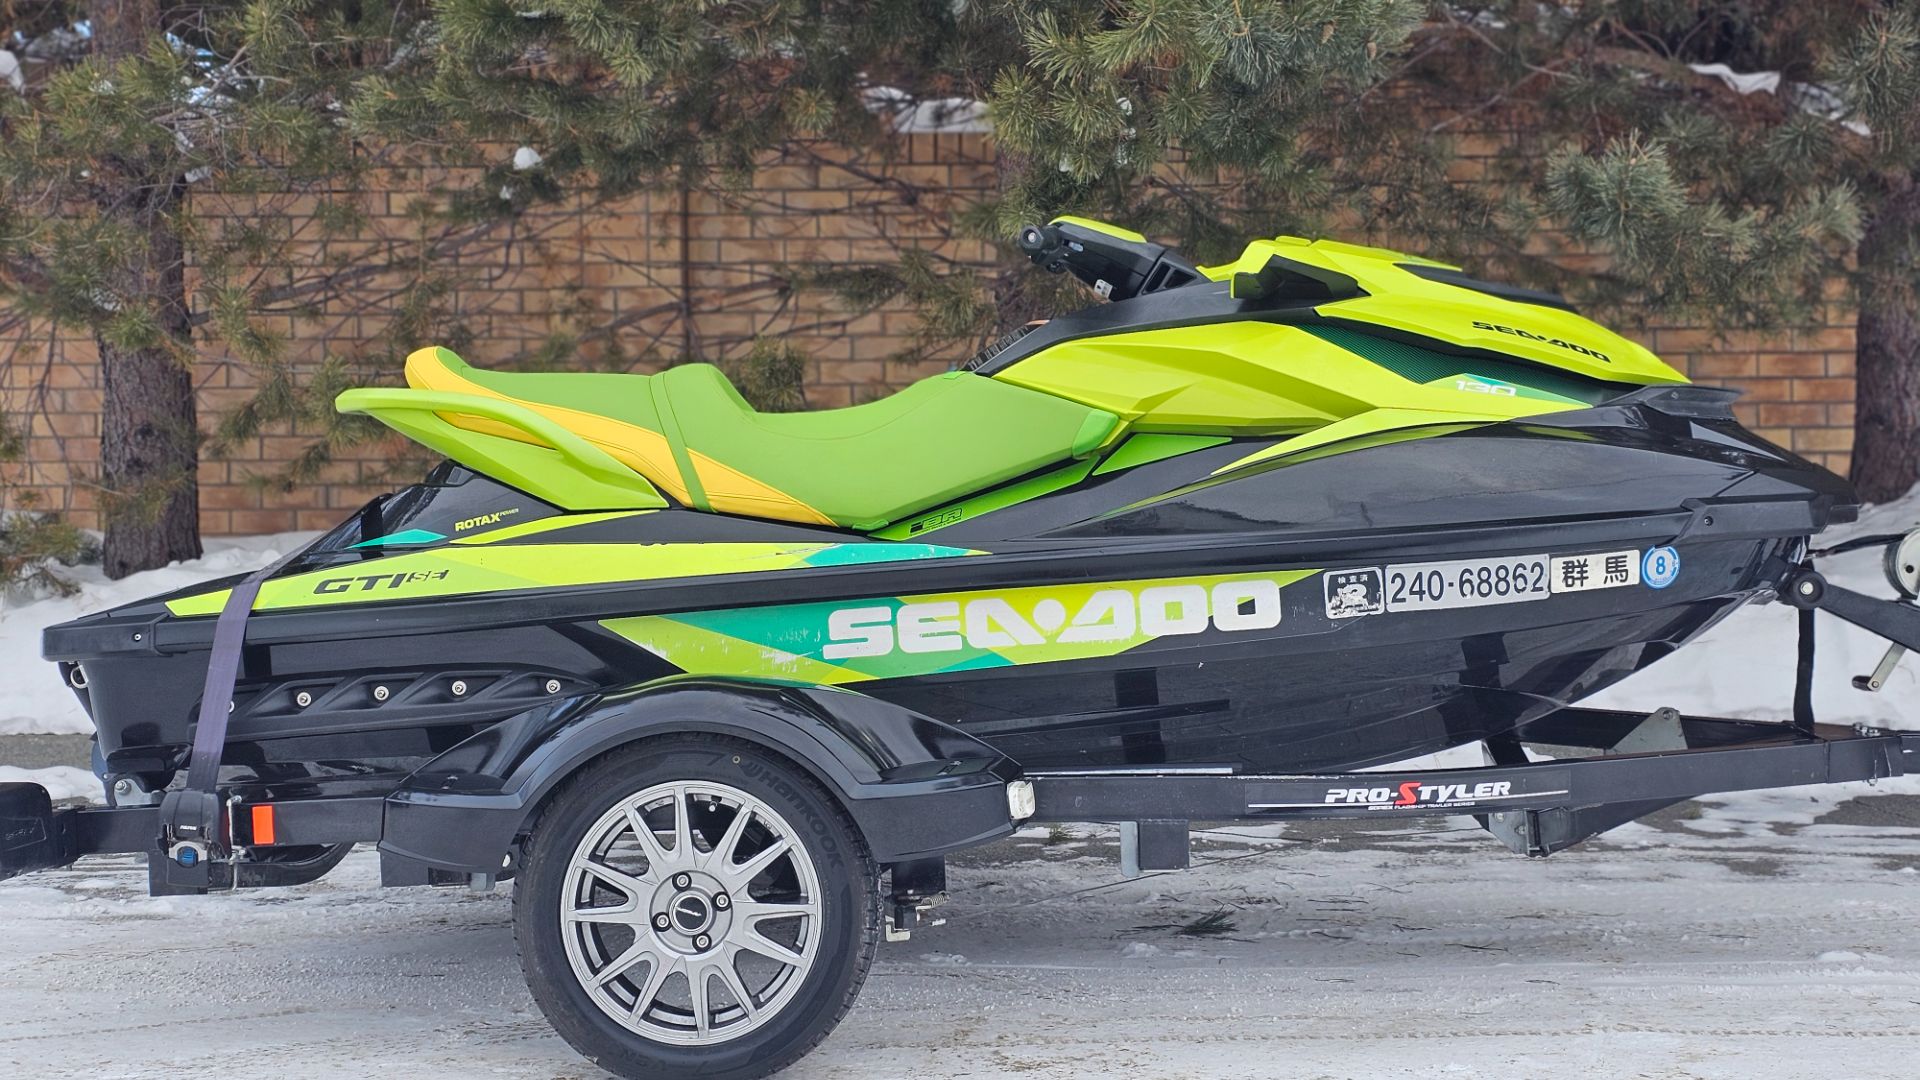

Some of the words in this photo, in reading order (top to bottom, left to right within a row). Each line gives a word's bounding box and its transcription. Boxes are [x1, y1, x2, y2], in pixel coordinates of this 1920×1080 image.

[1455, 379, 1517, 397] 130
[455, 512, 501, 532] ROTAX
[500, 508, 519, 517] POWER
[1655, 555, 1666, 576] 8
[313, 572, 408, 595] GTI
[1389, 561, 1546, 604] 240-68862
[1325, 781, 1512, 806] PRO-STYLER
